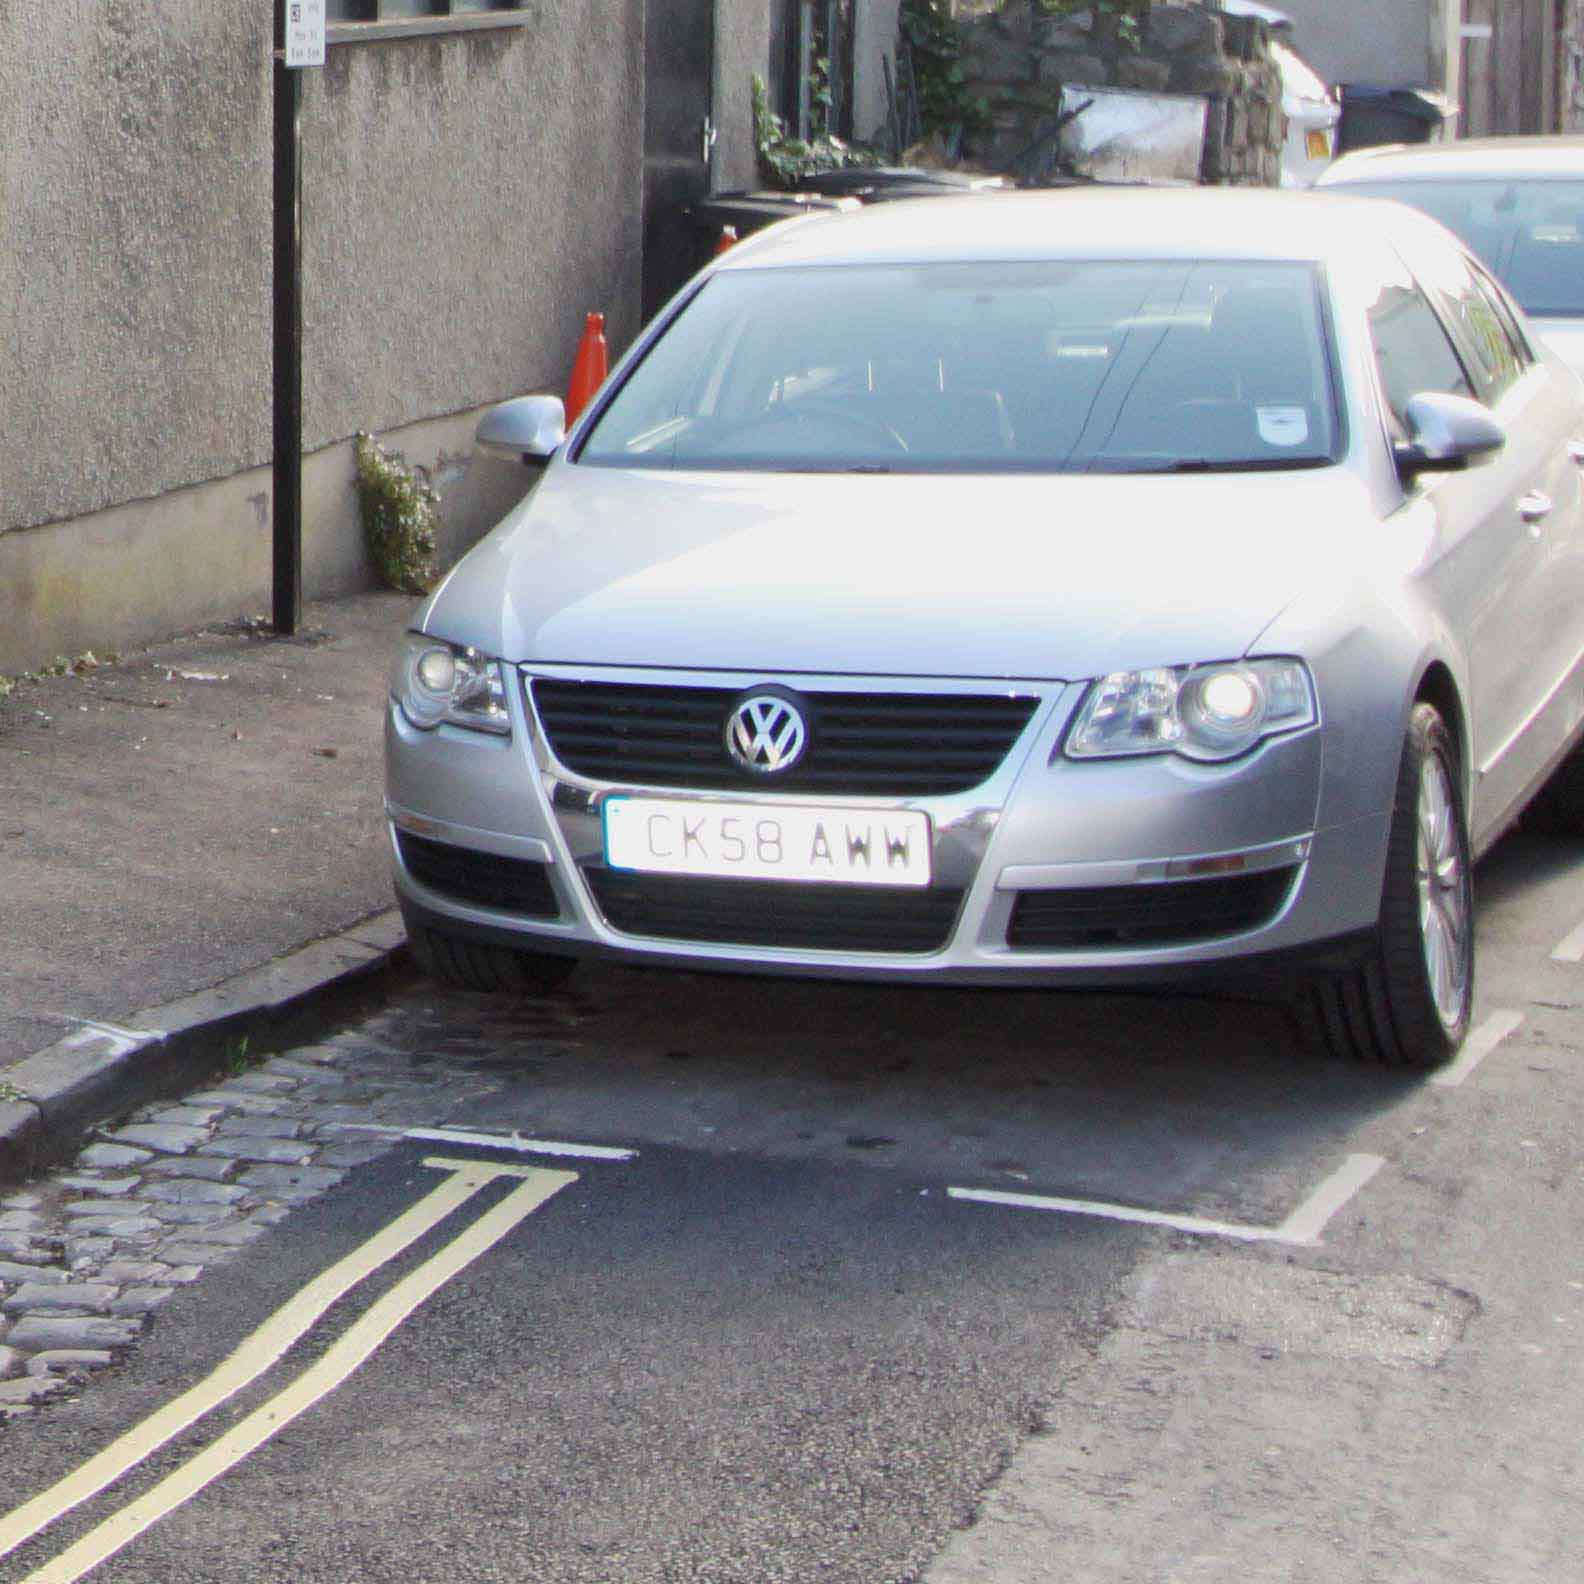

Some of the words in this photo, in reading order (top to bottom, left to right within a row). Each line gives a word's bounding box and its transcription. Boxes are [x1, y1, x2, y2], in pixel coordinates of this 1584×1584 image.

[728, 696, 806, 772] VW
[646, 813, 784, 864] CK58
[808, 821, 916, 870] AWW
